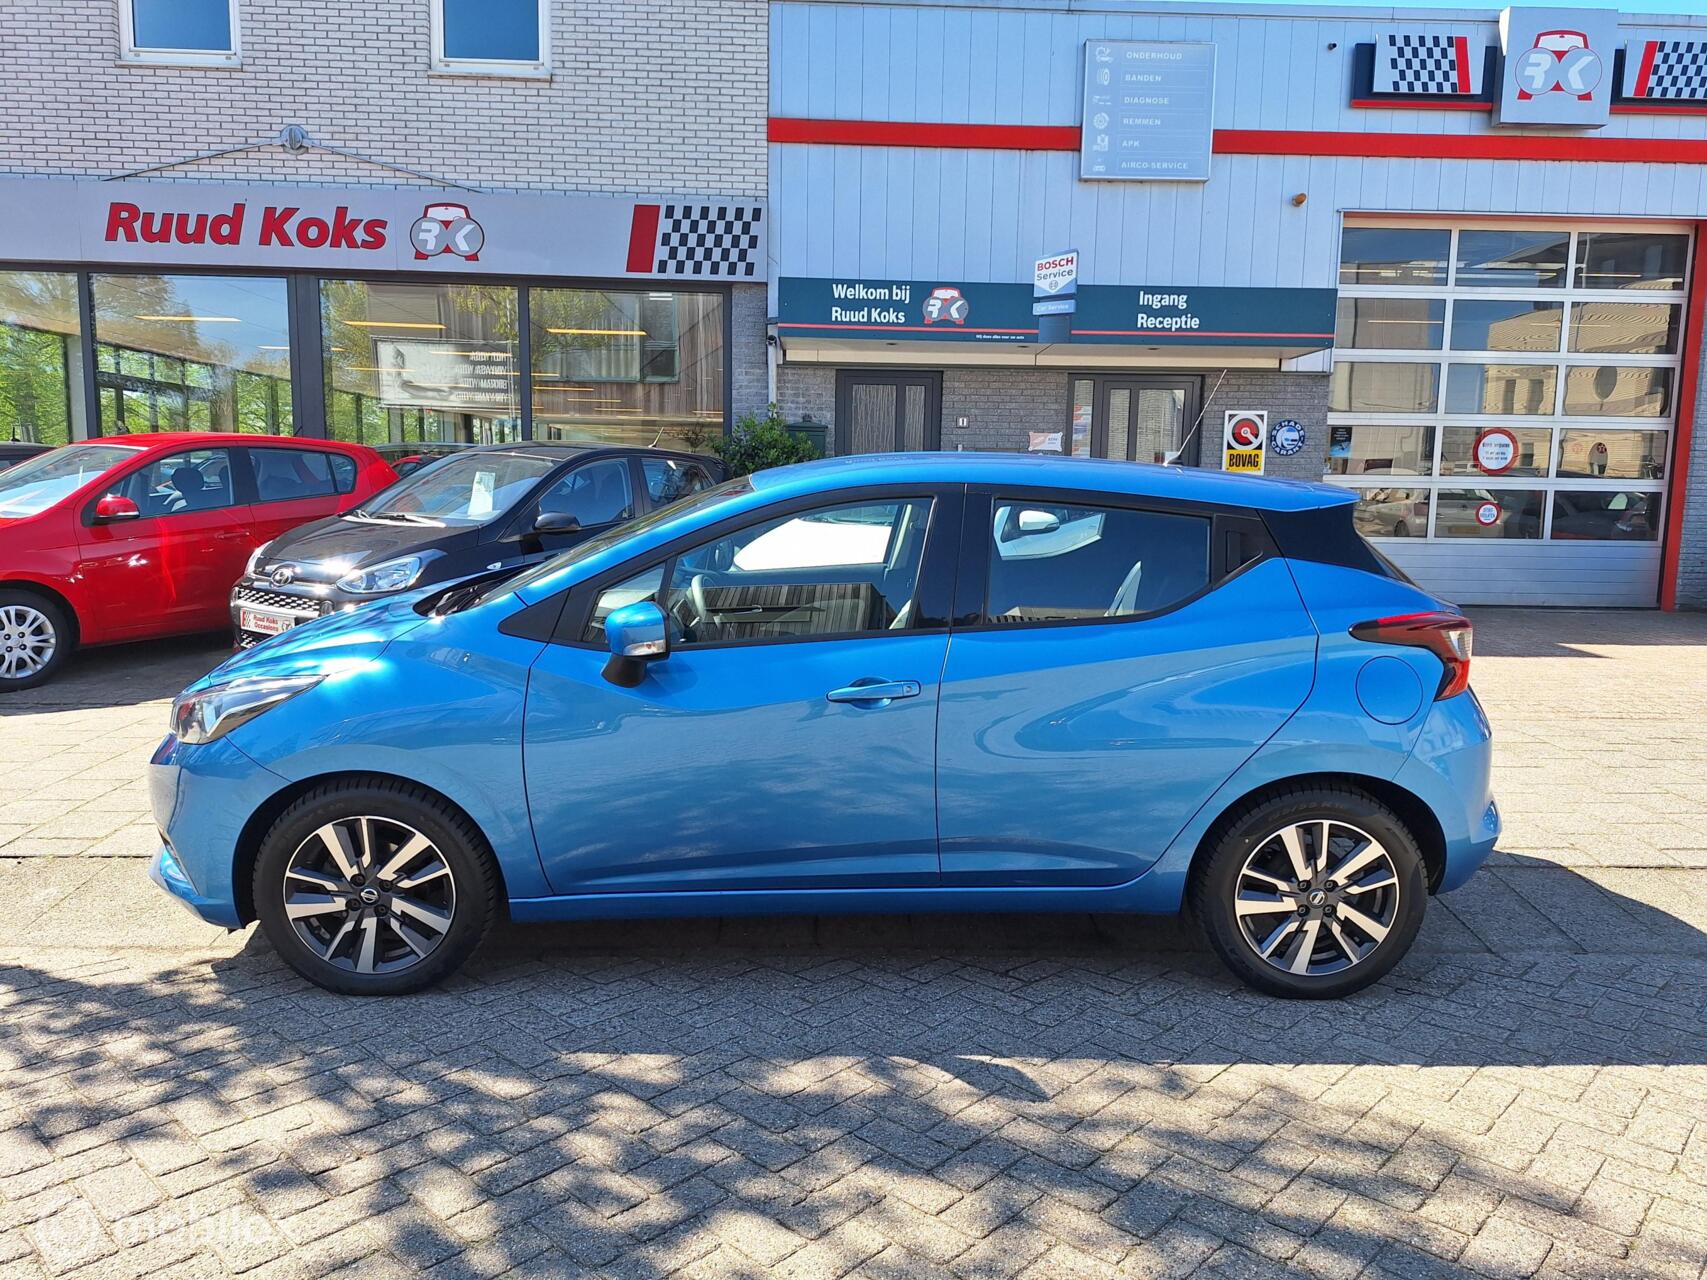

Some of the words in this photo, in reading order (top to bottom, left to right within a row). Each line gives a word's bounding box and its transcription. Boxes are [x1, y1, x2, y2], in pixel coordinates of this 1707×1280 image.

[1126, 51, 1183, 60] ONDERHOUD
[1125, 74, 1162, 82] BANDEN
[1124, 96, 1169, 104] DIAGNOSE
[1123, 117, 1161, 126] REMMEN
[1121, 161, 1188, 169] AIRCO-SERVICE
[105, 202, 246, 244] Ruud
[259, 207, 388, 250] Koks
[1037, 256, 1074, 271] BOSCH
[1036, 268, 1074, 281] Service
[832, 284, 889, 300] Welkom
[892, 285, 911, 304] bij
[1139, 291, 1188, 310] Ingang
[831, 306, 868, 322] Ruud
[871, 308, 906, 323] Koks
[1137, 313, 1200, 332] Receptie
[1229, 453, 1259, 468] BOVAG
